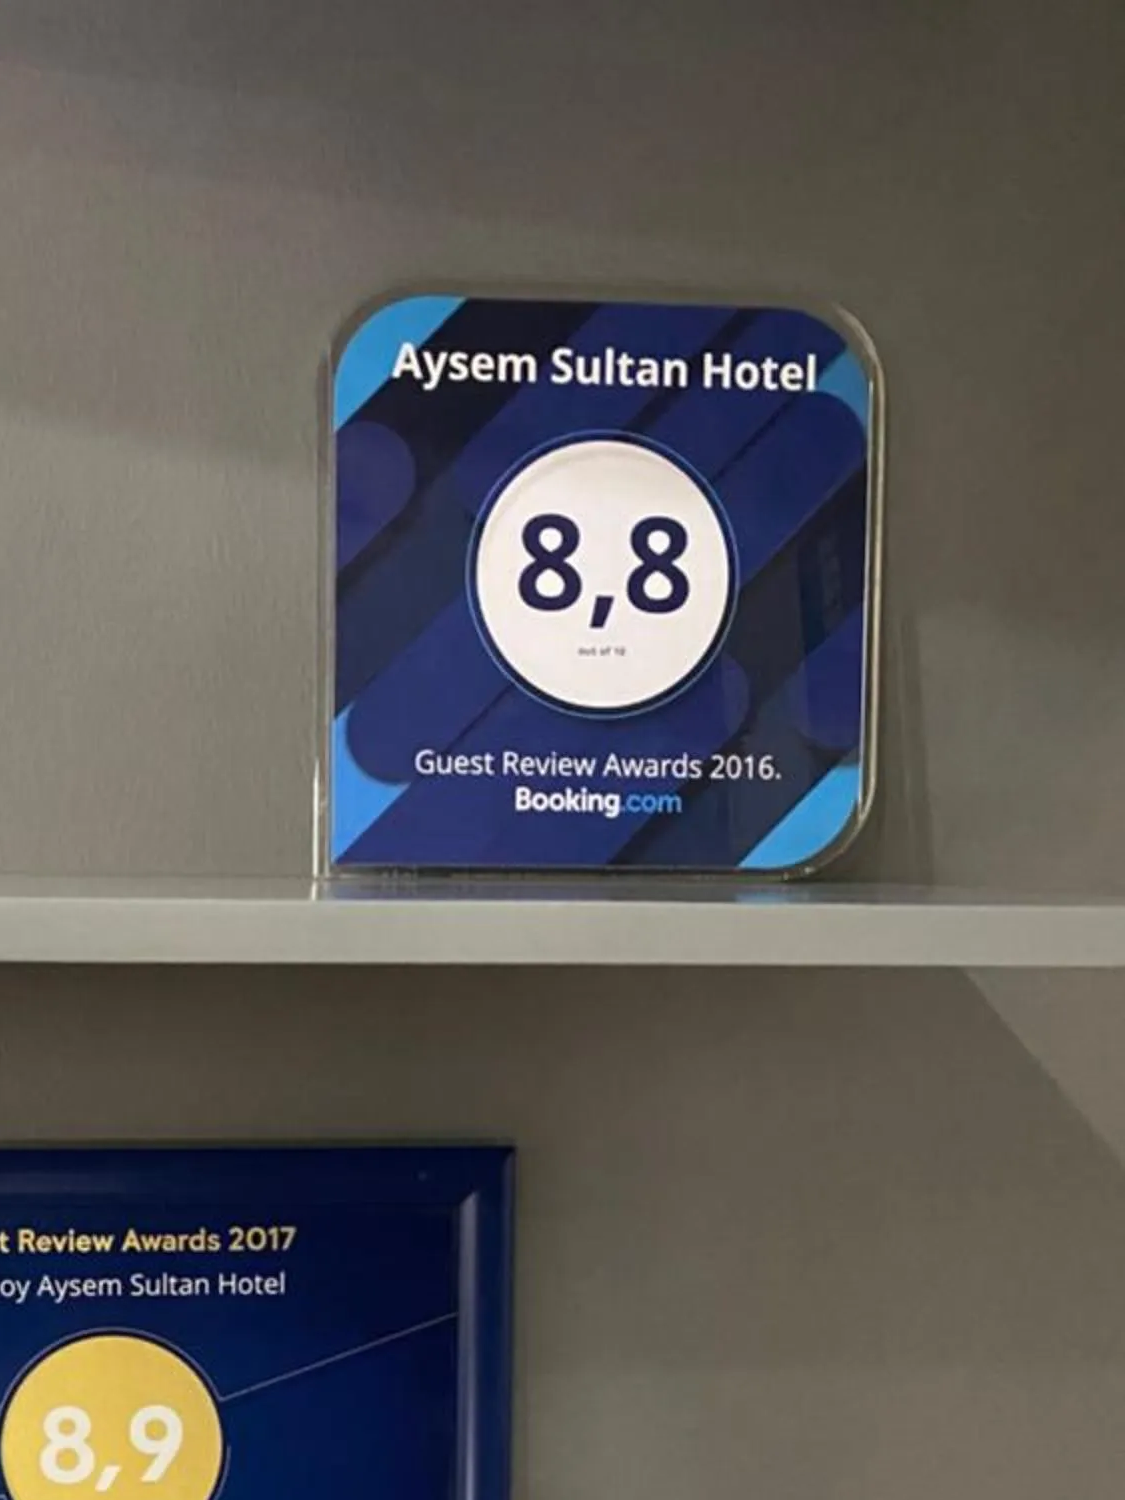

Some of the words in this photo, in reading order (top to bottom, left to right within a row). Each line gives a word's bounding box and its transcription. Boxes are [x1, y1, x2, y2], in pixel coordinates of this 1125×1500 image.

[393, 343, 537, 391] Aysem
[551, 347, 688, 389] Sultan
[703, 353, 817, 391] Hotel
[518, 513, 690, 628] 8,8
[415, 751, 494, 777] Guest
[503, 752, 596, 777] Review
[603, 754, 702, 780] Awards
[710, 755, 782, 780] 2016.
[515, 787, 682, 818] Booking.com
[18, 1228, 115, 1253] Review
[121, 1227, 221, 1252] Awards
[228, 1227, 297, 1251] 2017
[37, 1275, 122, 1302] Aysem
[130, 1272, 210, 1296] Sultan
[218, 1271, 286, 1295] Hotel
[39, 1405, 183, 1492] 8,9
